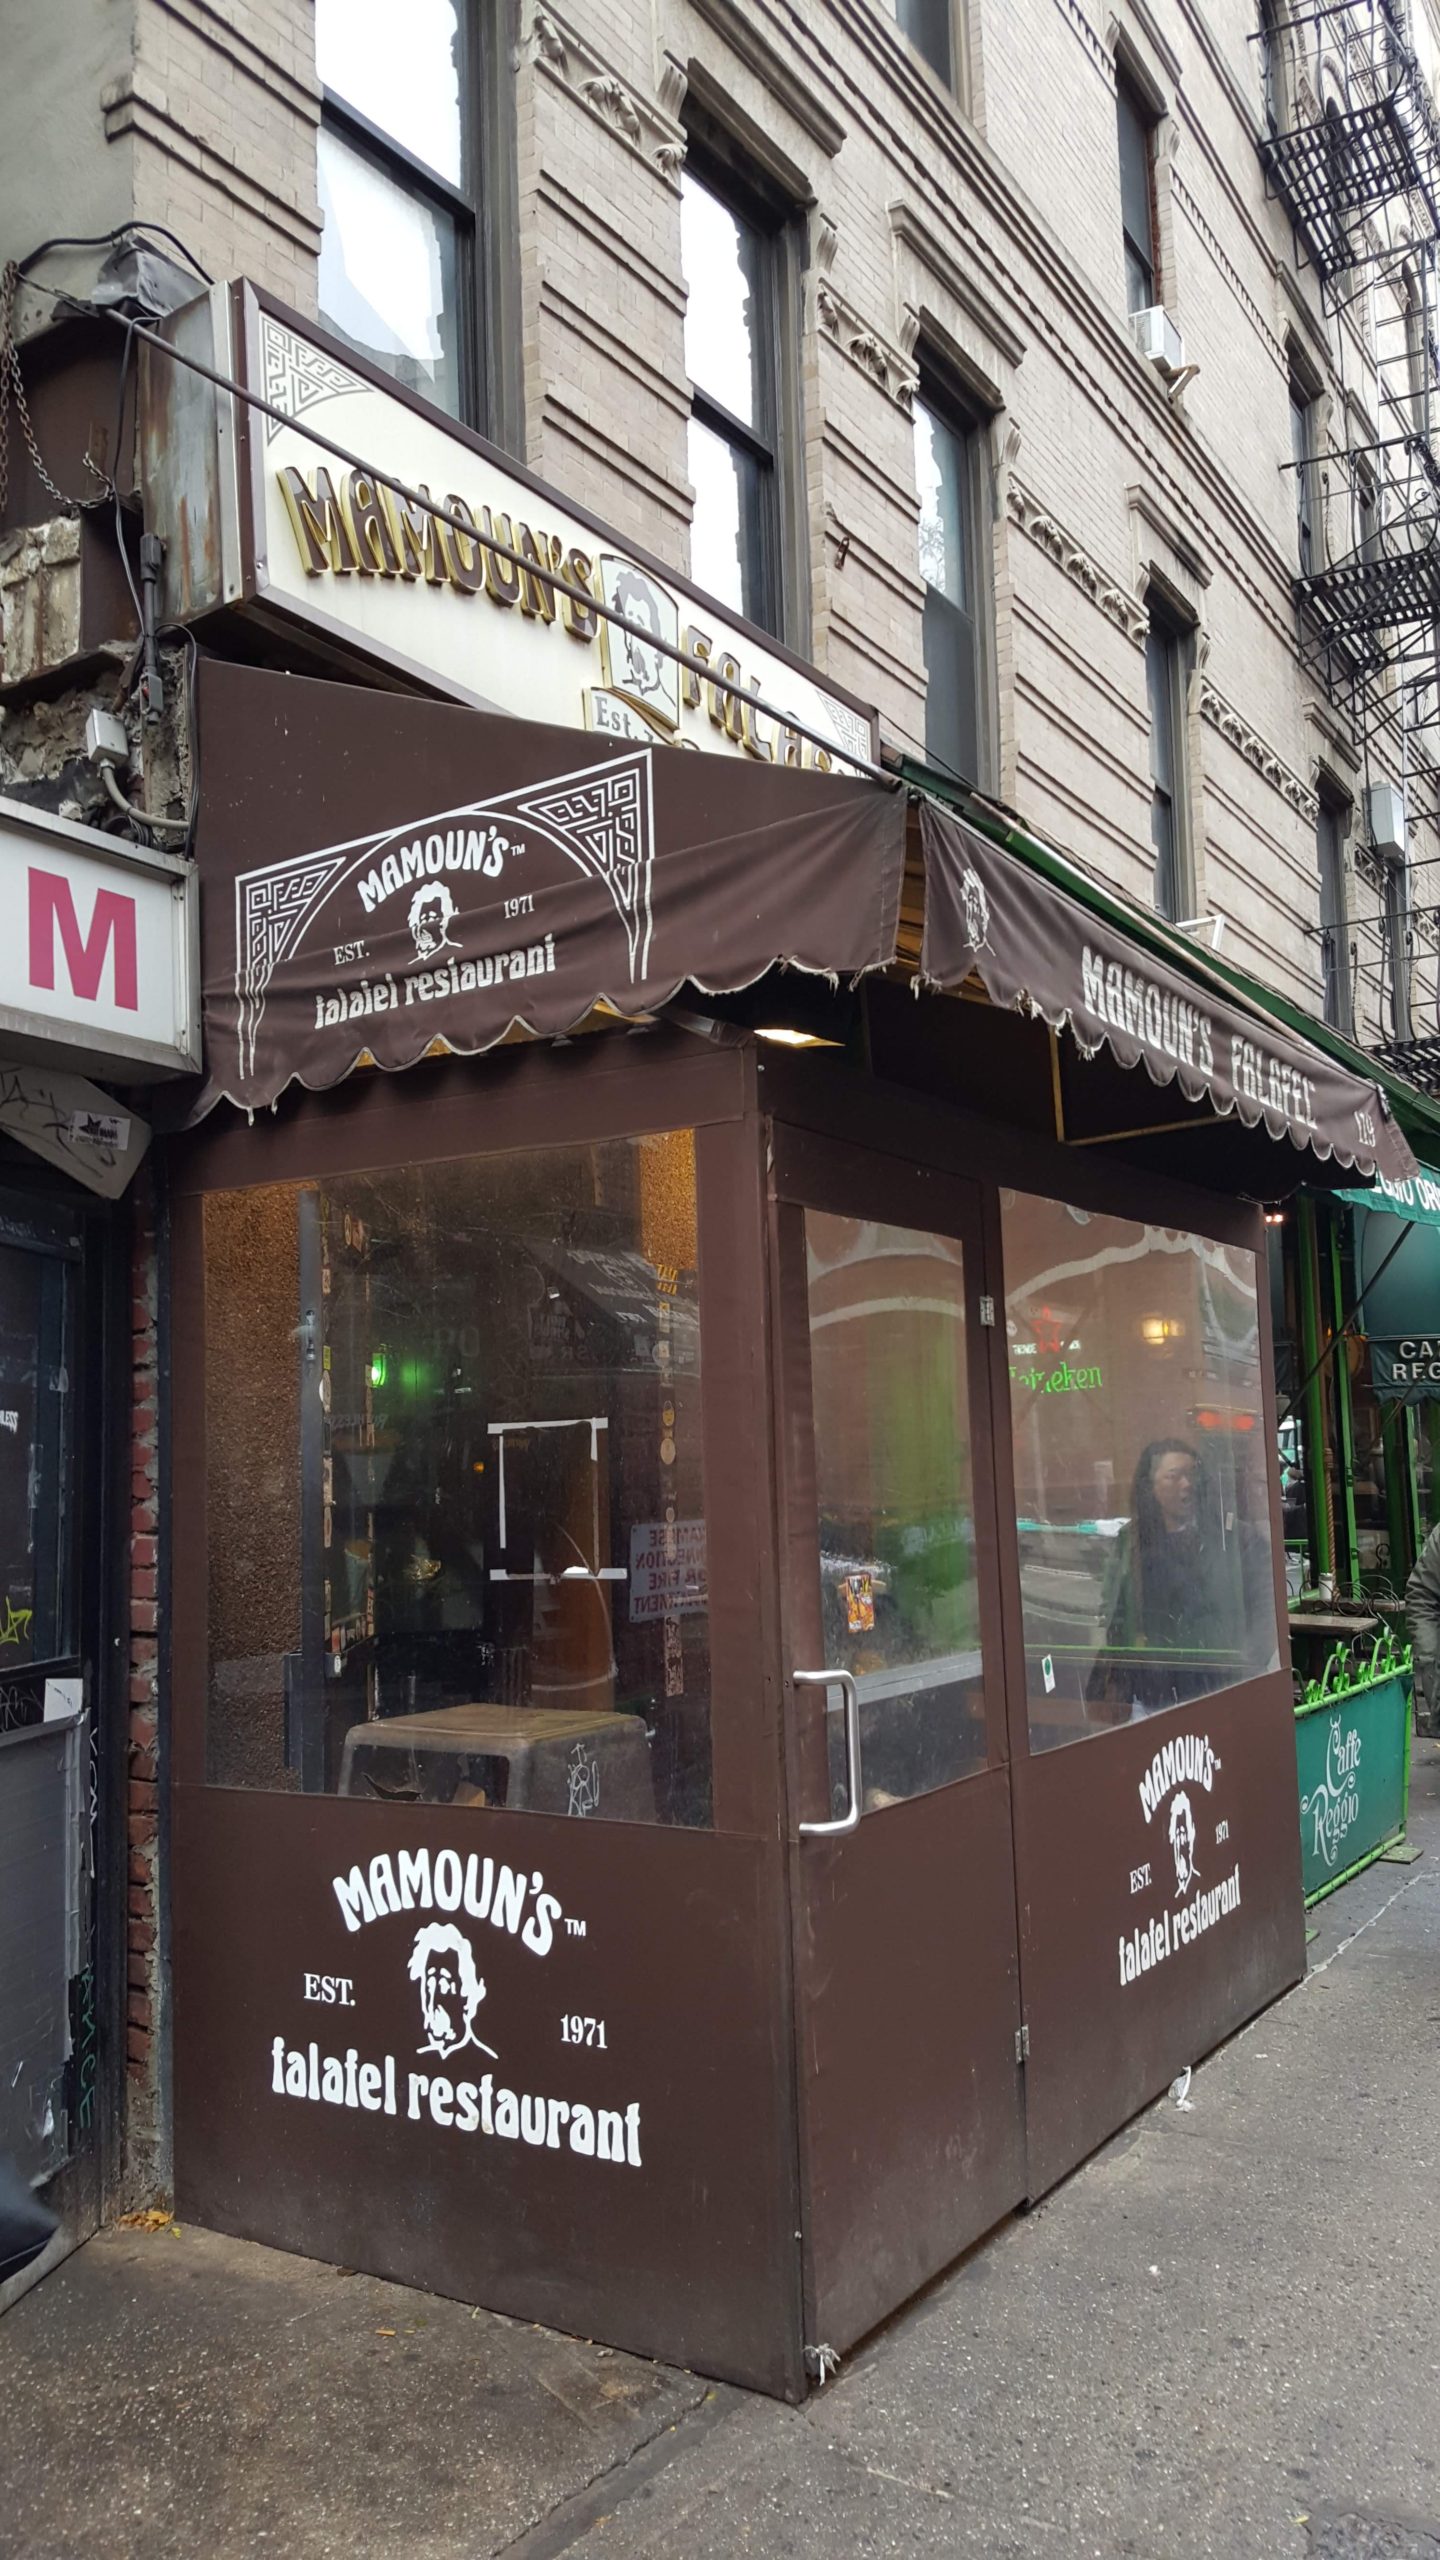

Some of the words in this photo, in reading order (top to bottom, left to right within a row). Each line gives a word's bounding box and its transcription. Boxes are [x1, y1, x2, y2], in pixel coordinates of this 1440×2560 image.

[276, 466, 600, 642] MAMOUN'S
[357, 826, 509, 913] MAMOUN'S
[503, 895, 535, 919] 1971
[28, 866, 138, 1012] M
[333, 940, 370, 966] EST.
[1081, 945, 1214, 1077] MAMOUN'S
[1231, 1034, 1319, 1130] FALAFEL
[1138, 1734, 1215, 1824] MAMOUN'S
[1326, 1716, 1362, 1797] Caffe
[1215, 1820, 1230, 1845] 1971
[1301, 1784, 1360, 1867] Reggio
[332, 1848, 562, 1956] MAMOUN'S
[1129, 1862, 1152, 1894] EST.
[1119, 1909, 1171, 1987] falafel
[1173, 1863, 1241, 1951] restaurant
[303, 1973, 356, 2006] EST.
[560, 2014, 608, 2049] 1971
[271, 2036, 397, 2115] falafel
[407, 2073, 642, 2167] restaurant
